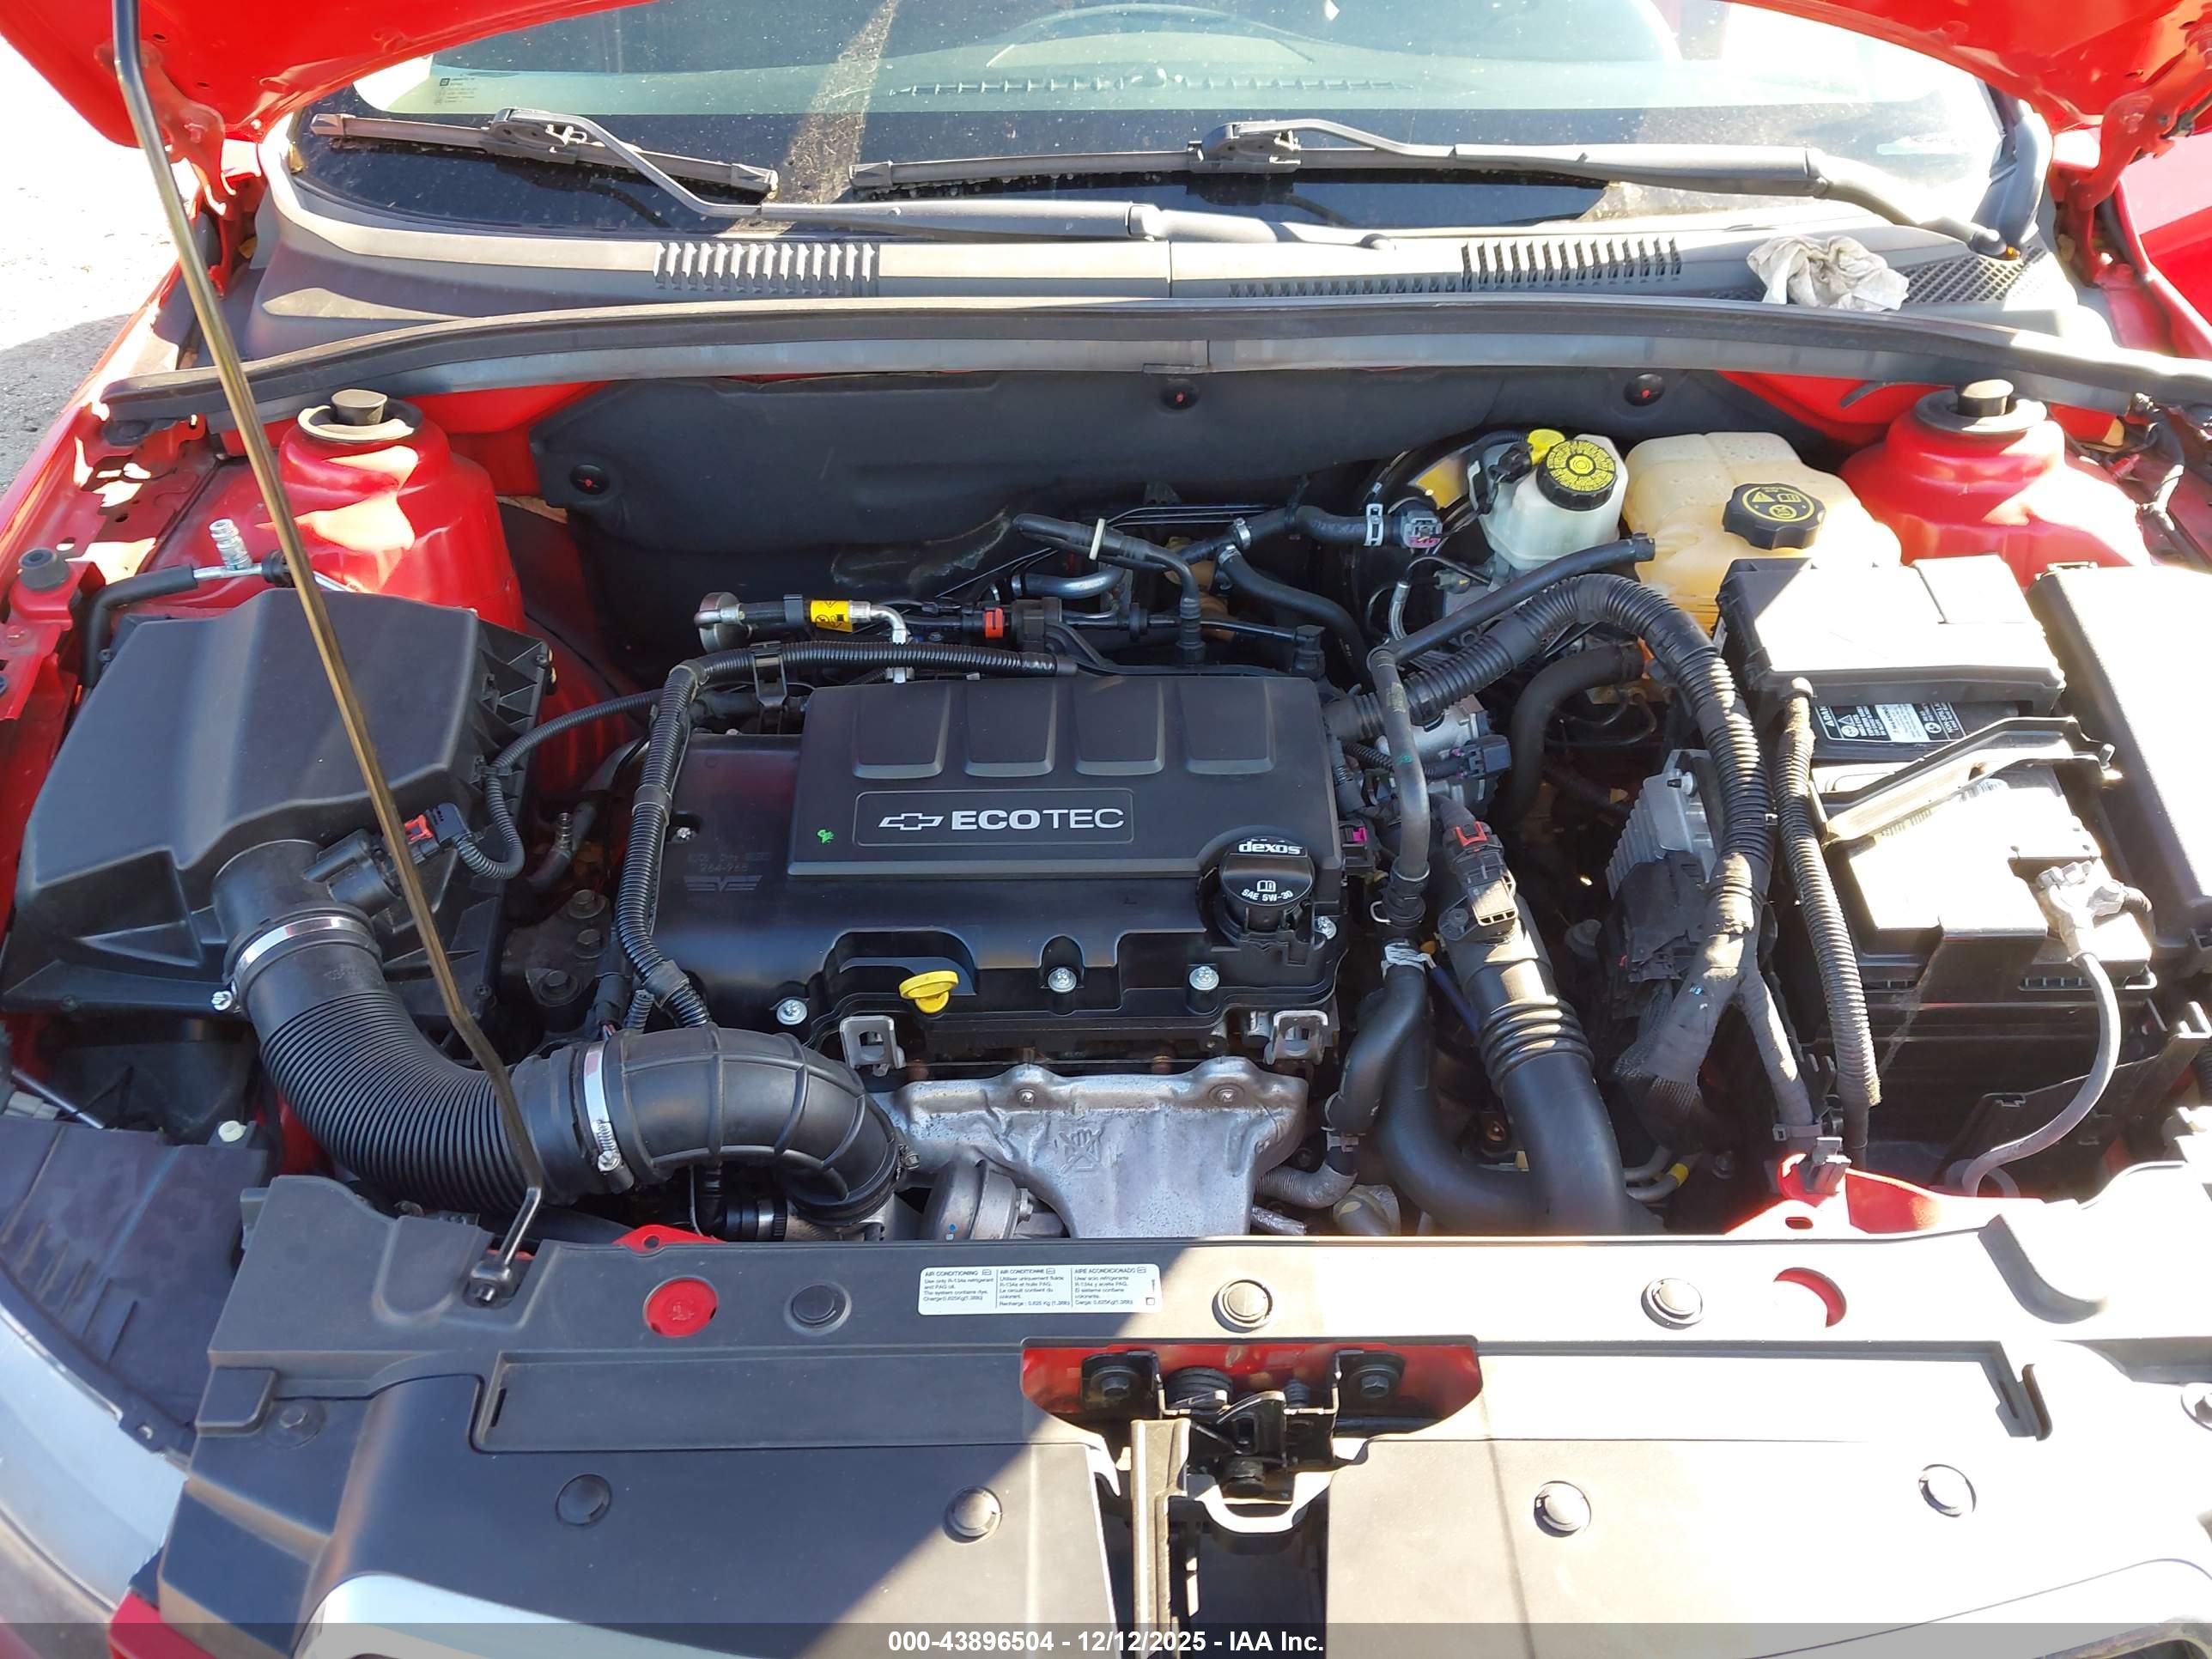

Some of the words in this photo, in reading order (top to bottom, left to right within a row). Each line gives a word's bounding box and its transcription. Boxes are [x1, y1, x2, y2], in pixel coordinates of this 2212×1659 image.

[951, 808, 1124, 830] ECOTEC
[1238, 842, 1303, 855] dexos
[1241, 889, 1260, 901] SAE
[1261, 890, 1294, 902] 5W-30
